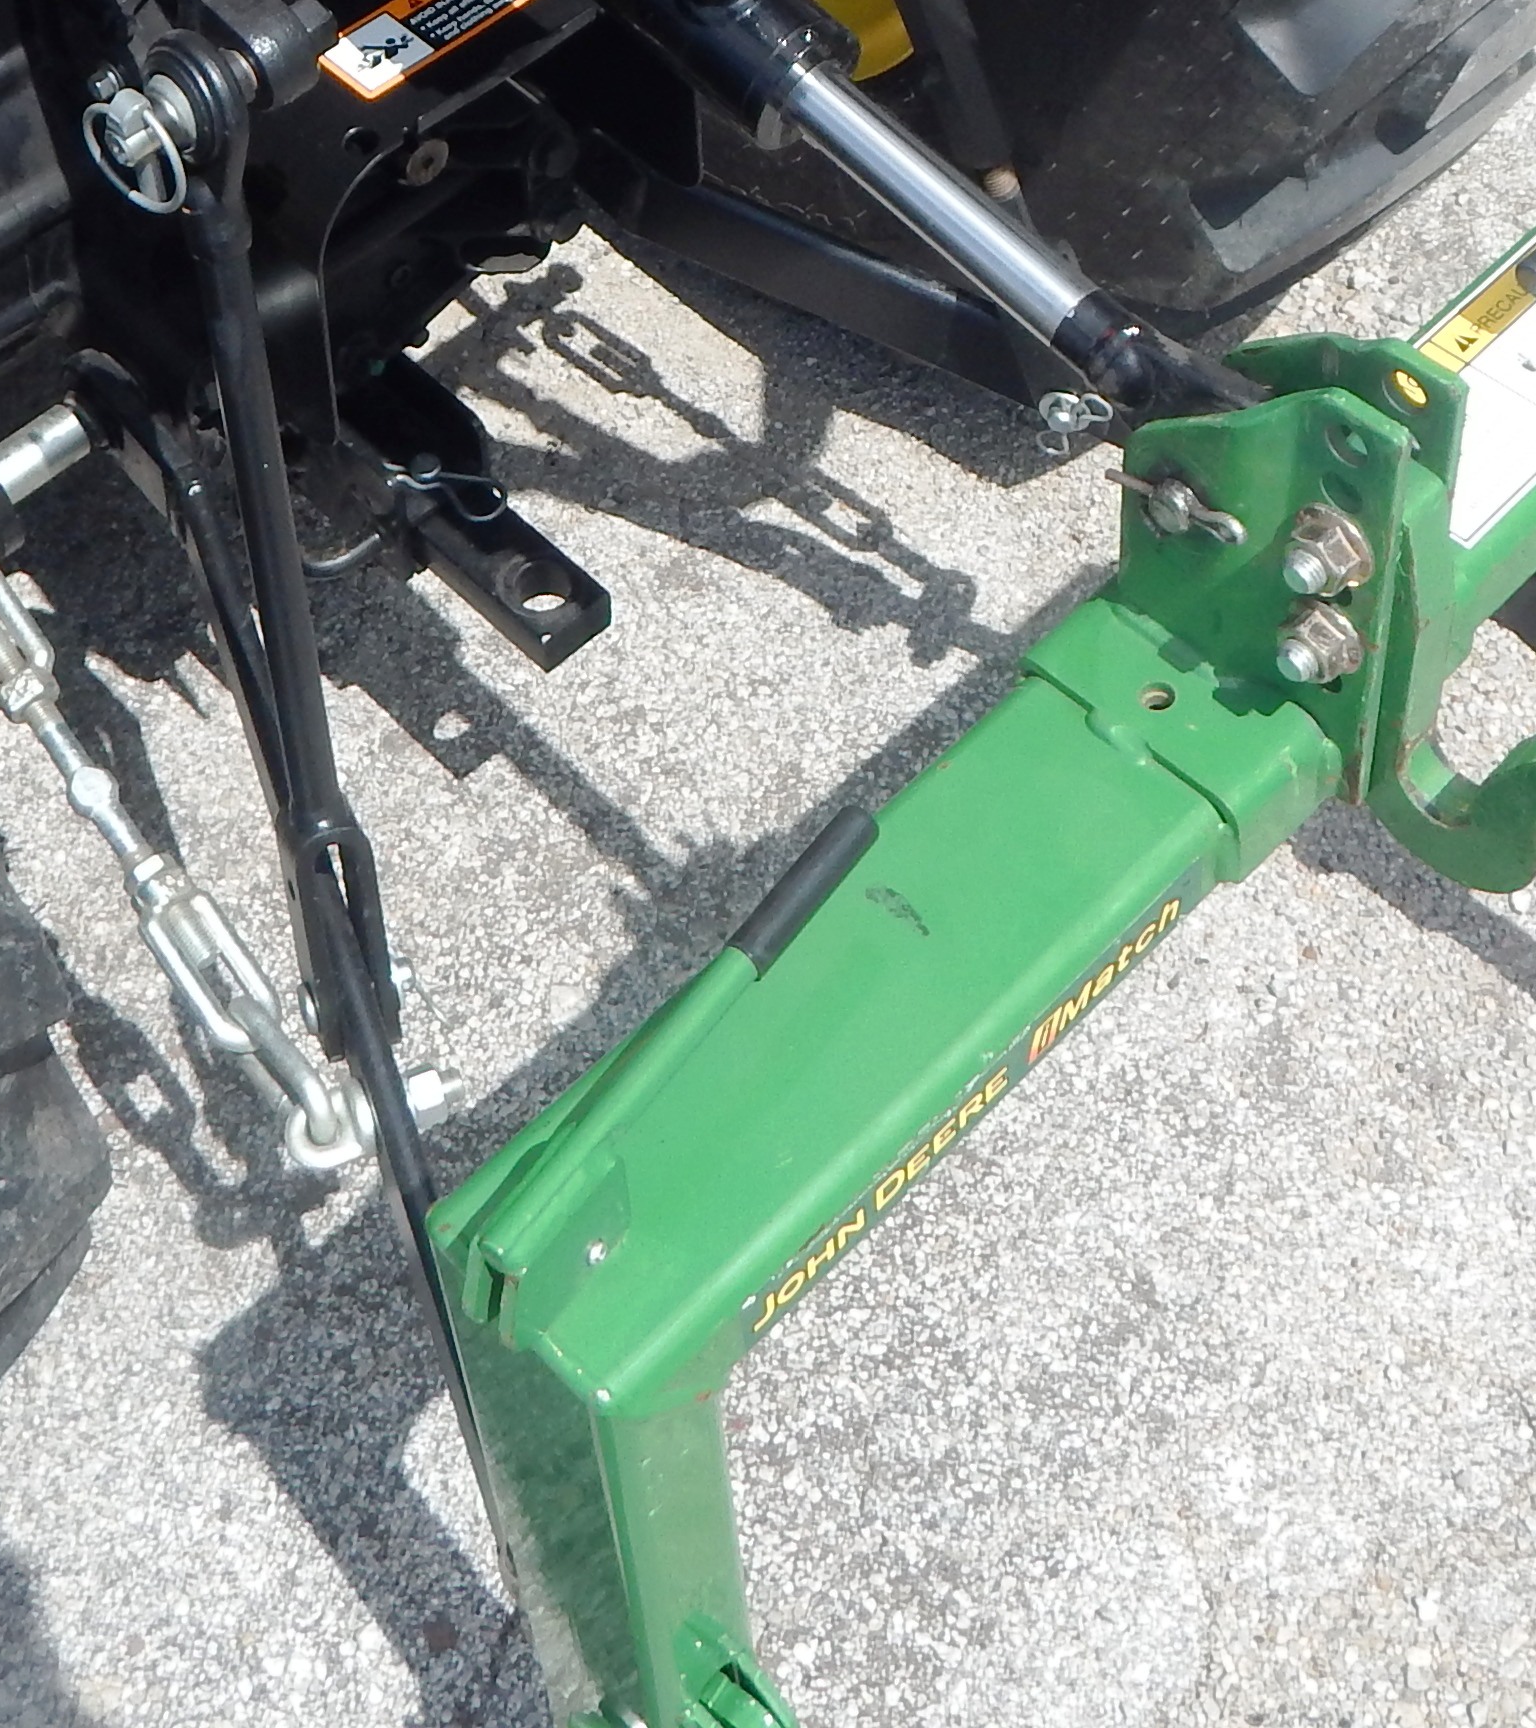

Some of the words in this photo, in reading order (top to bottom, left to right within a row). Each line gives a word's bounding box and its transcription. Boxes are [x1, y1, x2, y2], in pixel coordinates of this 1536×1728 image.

[1470, 288, 1529, 335] PRECAU
[753, 1208, 867, 1333] JOHN
[875, 1066, 1011, 1212] DEERE
